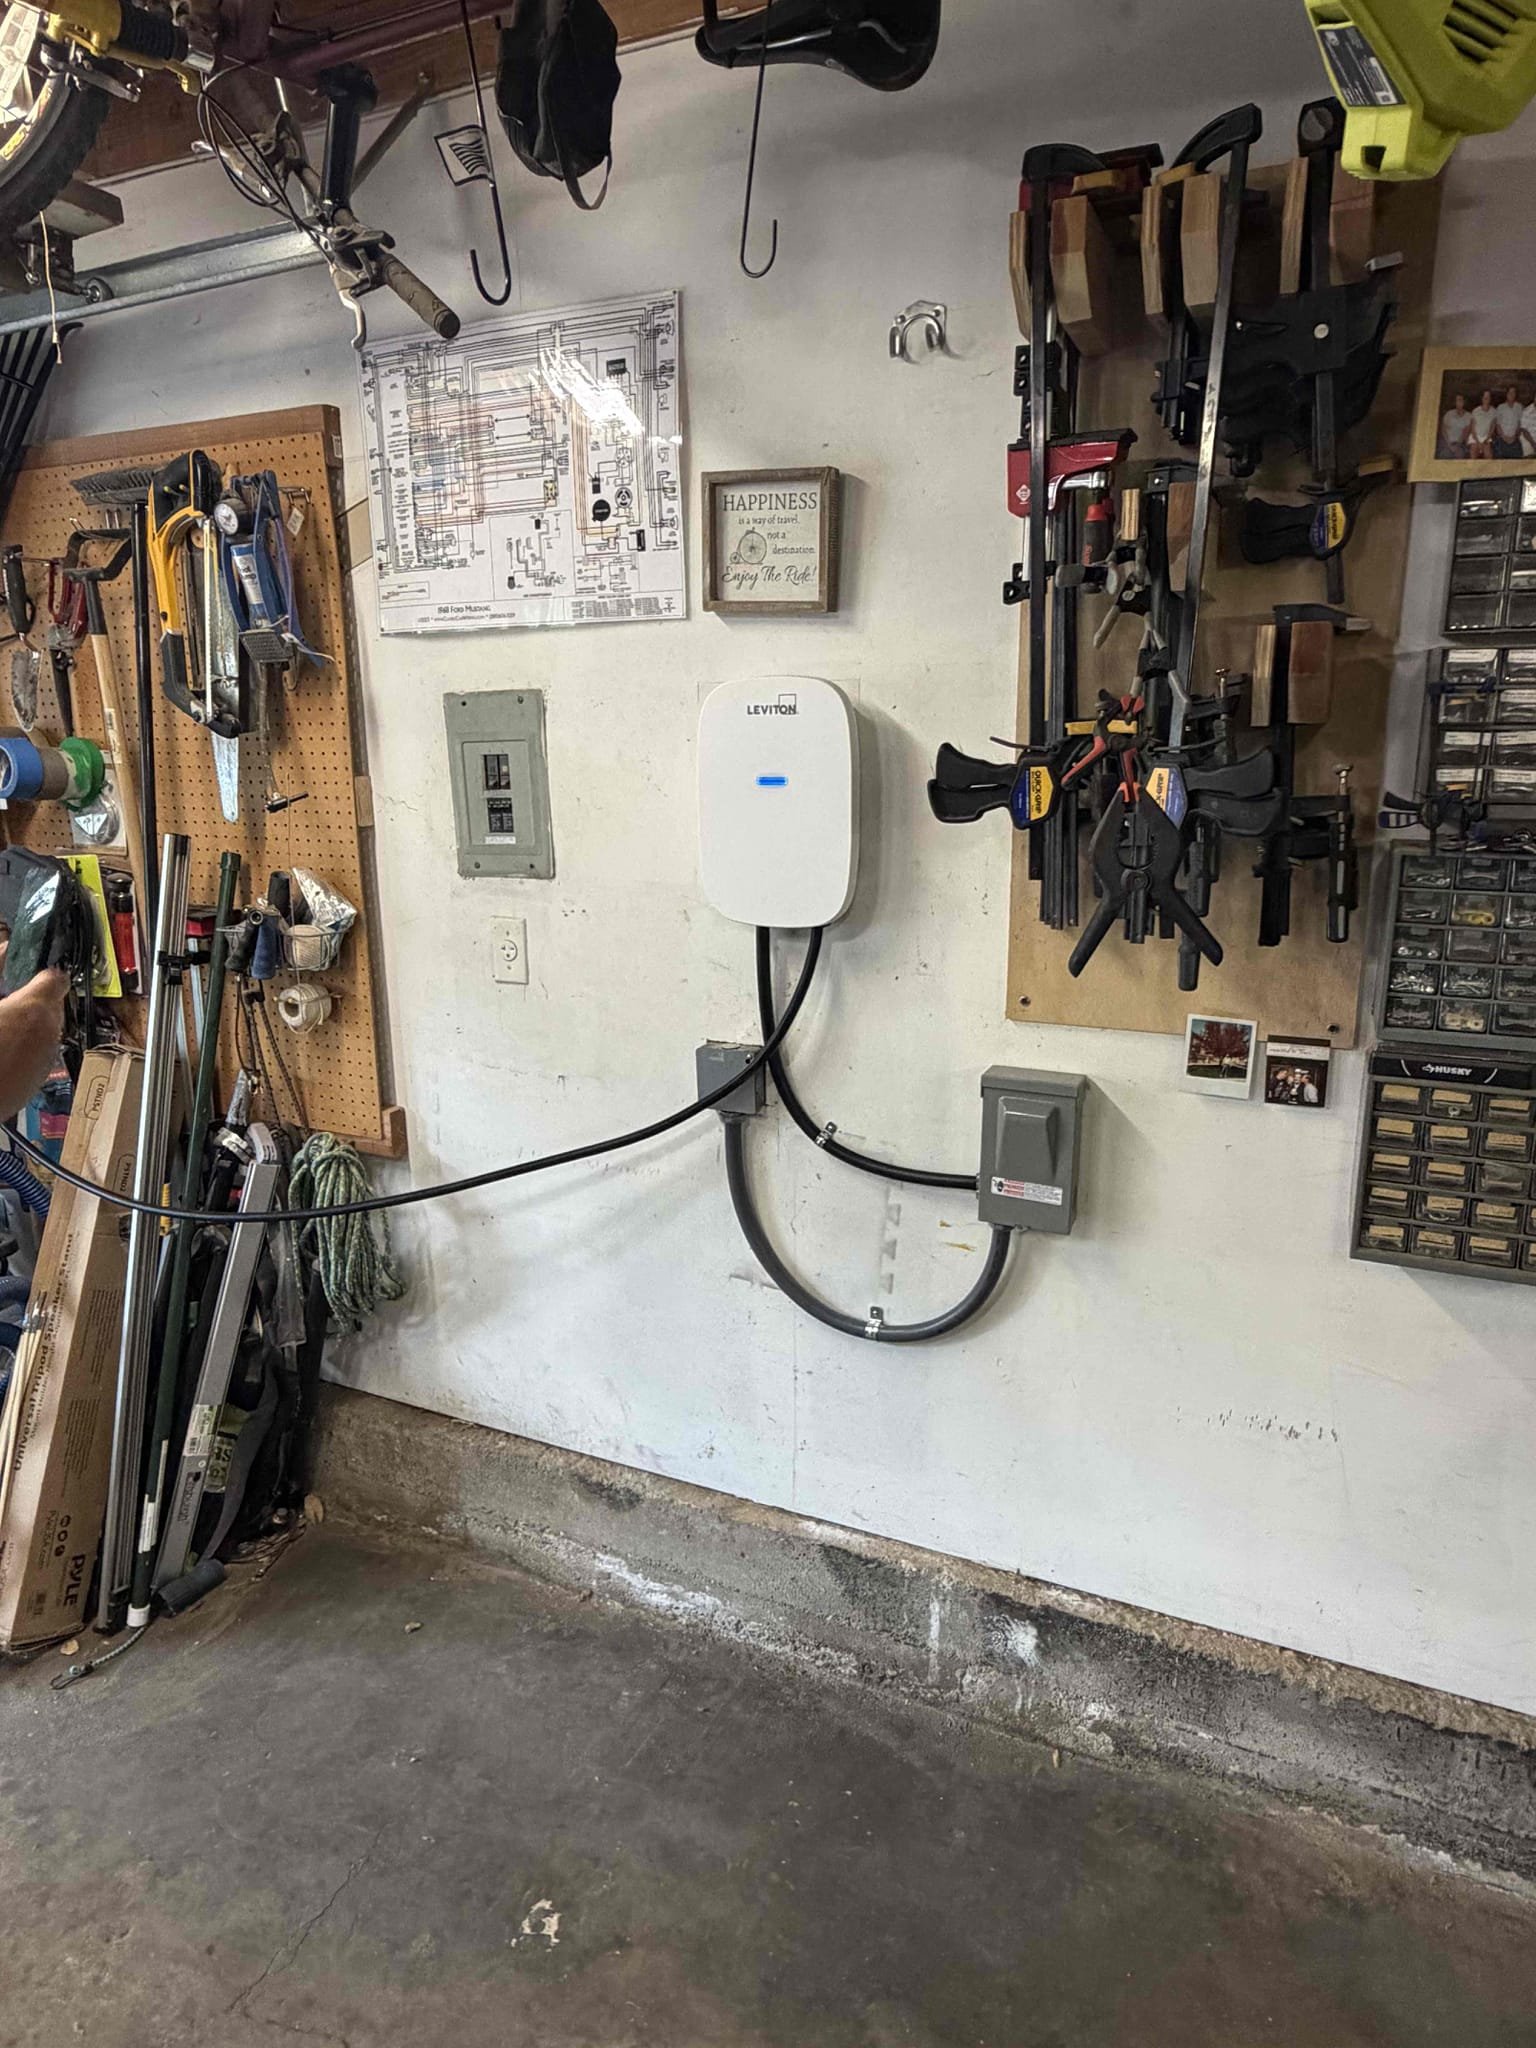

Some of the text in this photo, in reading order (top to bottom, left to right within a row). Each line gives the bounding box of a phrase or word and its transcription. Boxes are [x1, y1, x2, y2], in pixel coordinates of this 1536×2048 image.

[723, 492, 818, 511] HAPPINESS
[752, 517, 766, 526] way
[767, 514, 777, 524] of
[767, 531, 780, 540] not
[721, 565, 818, 590] Enjoy The Ride!
[746, 704, 797, 715] LEVITON
[1435, 1065, 1473, 1076] HUSKY
[14, 1234, 73, 1471] Universal Tripod Speaker Stand
[63, 1553, 86, 1607] PYLE
